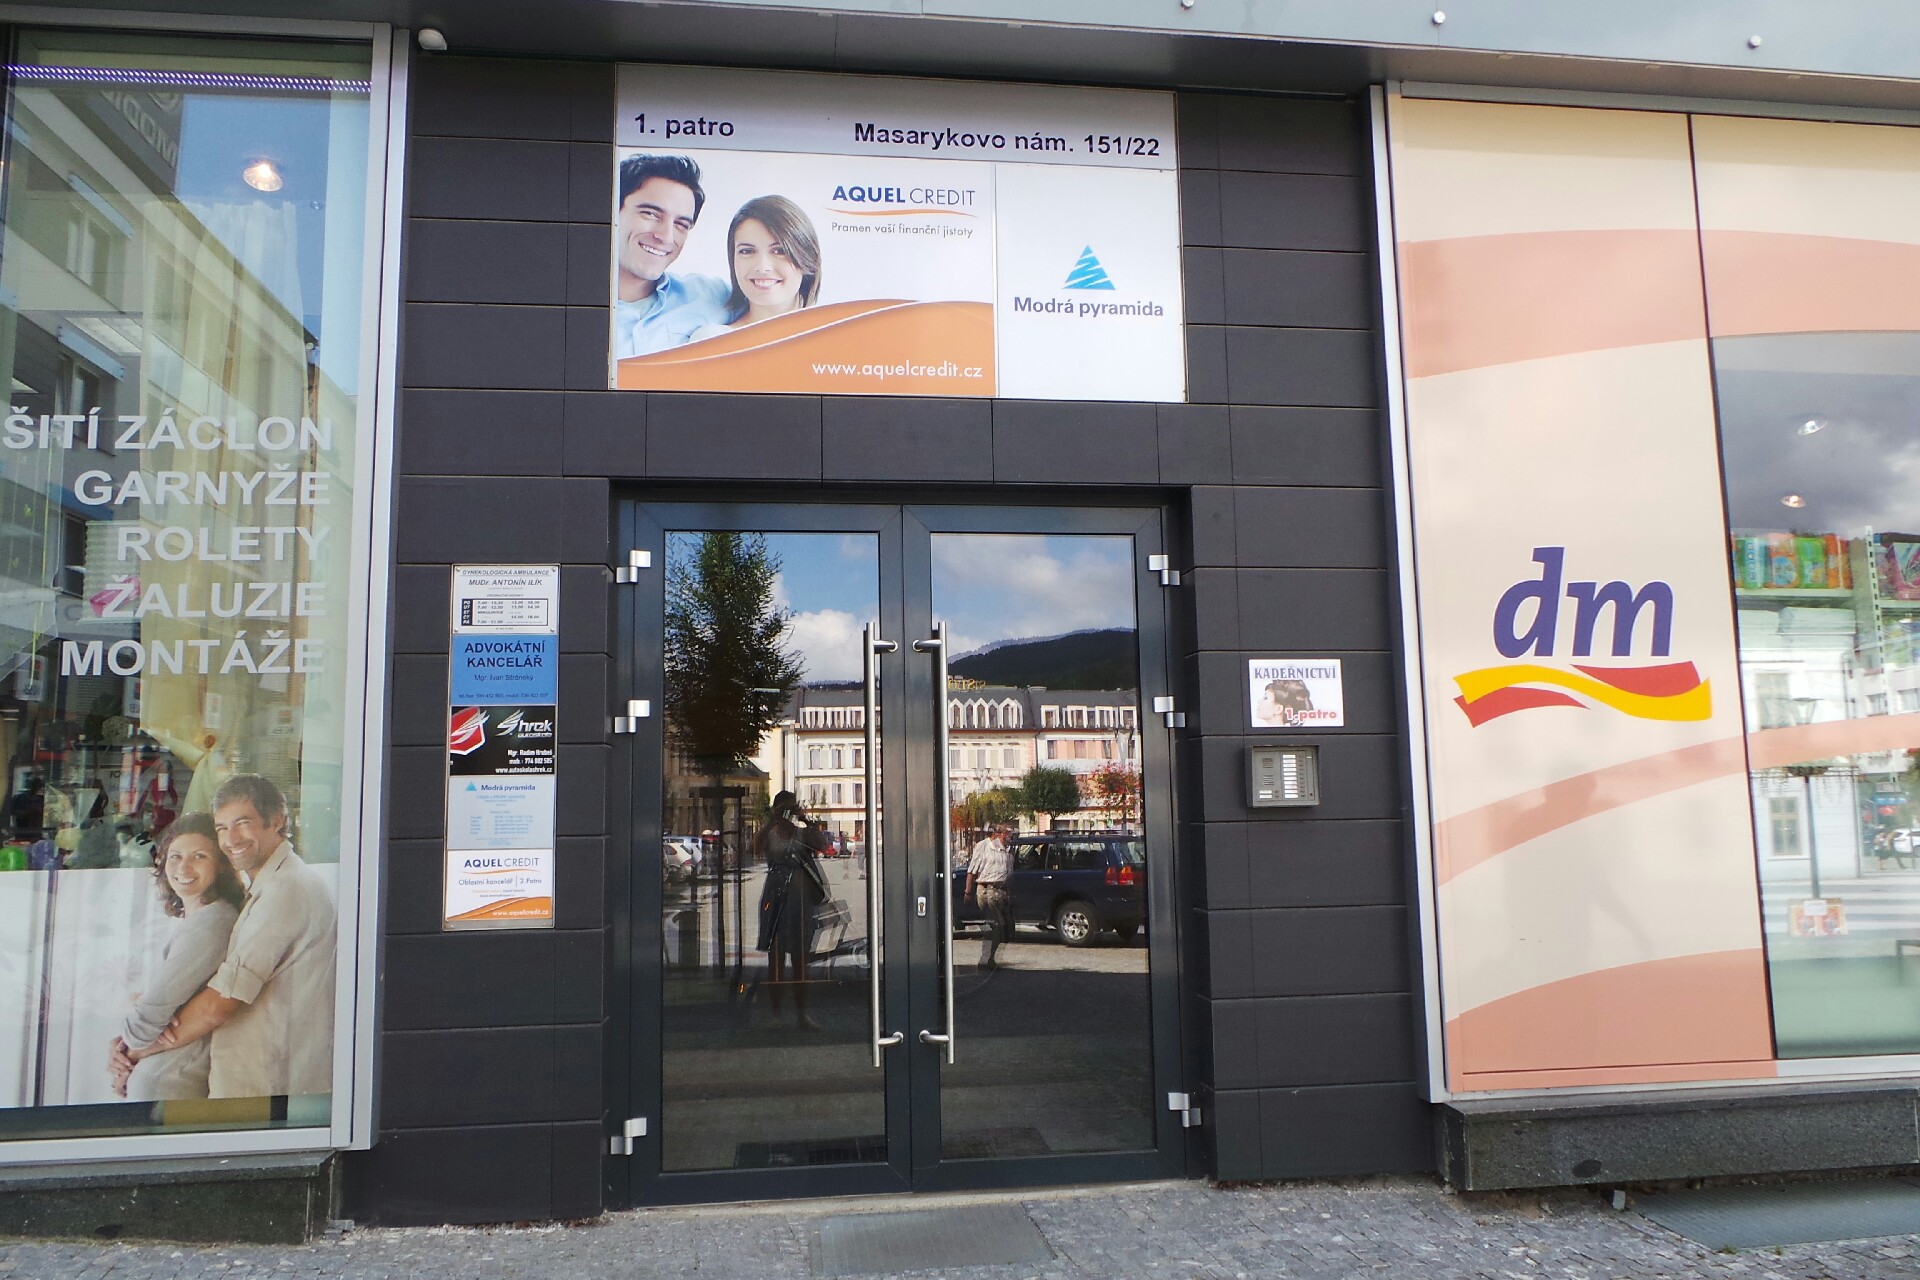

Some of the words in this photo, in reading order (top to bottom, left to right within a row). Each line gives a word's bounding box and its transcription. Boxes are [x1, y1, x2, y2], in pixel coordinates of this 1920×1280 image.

[634, 113, 655, 134] 1.
[665, 116, 735, 139] patro
[854, 122, 1006, 151] Masarykovo
[1014, 131, 1074, 153] nám.
[1083, 134, 1160, 157] 151/22
[832, 185, 906, 204] AQUEL
[909, 187, 976, 206] CREDIT
[831, 222, 871, 233] Pramen
[874, 223, 896, 234] vaší
[898, 223, 941, 235] finanční
[942, 226, 974, 238] jistoty
[1013, 296, 1074, 314] Modrá
[1079, 301, 1164, 318] pyramida
[811, 360, 983, 381] www.aquelcredit.cz
[2, 406, 101, 449] ŠITÍ
[114, 407, 332, 450] ZÁCLON
[74, 463, 330, 505] GARNYŽE
[117, 526, 331, 561] ROLETY
[492, 578, 526, 586] ANTONÍN
[528, 578, 543, 586] ILÍK
[102, 574, 327, 618] ŽALUZIE
[1492, 546, 1675, 659] dm
[61, 629, 325, 676] MONTÁŽE
[464, 640, 546, 653] ADVOKÁTNÍ
[467, 655, 543, 668] KANCELÁŘ
[1254, 665, 1336, 679] KADEŘNICTVÍ
[505, 674, 534, 682] Stránský
[504, 784, 536, 792] pyramida
[464, 859, 502, 868] AQUEL
[504, 858, 540, 867] CREDIT
[458, 878, 484, 886] Oblastní
[493, 909, 548, 917] www.aquelcredit.cz
